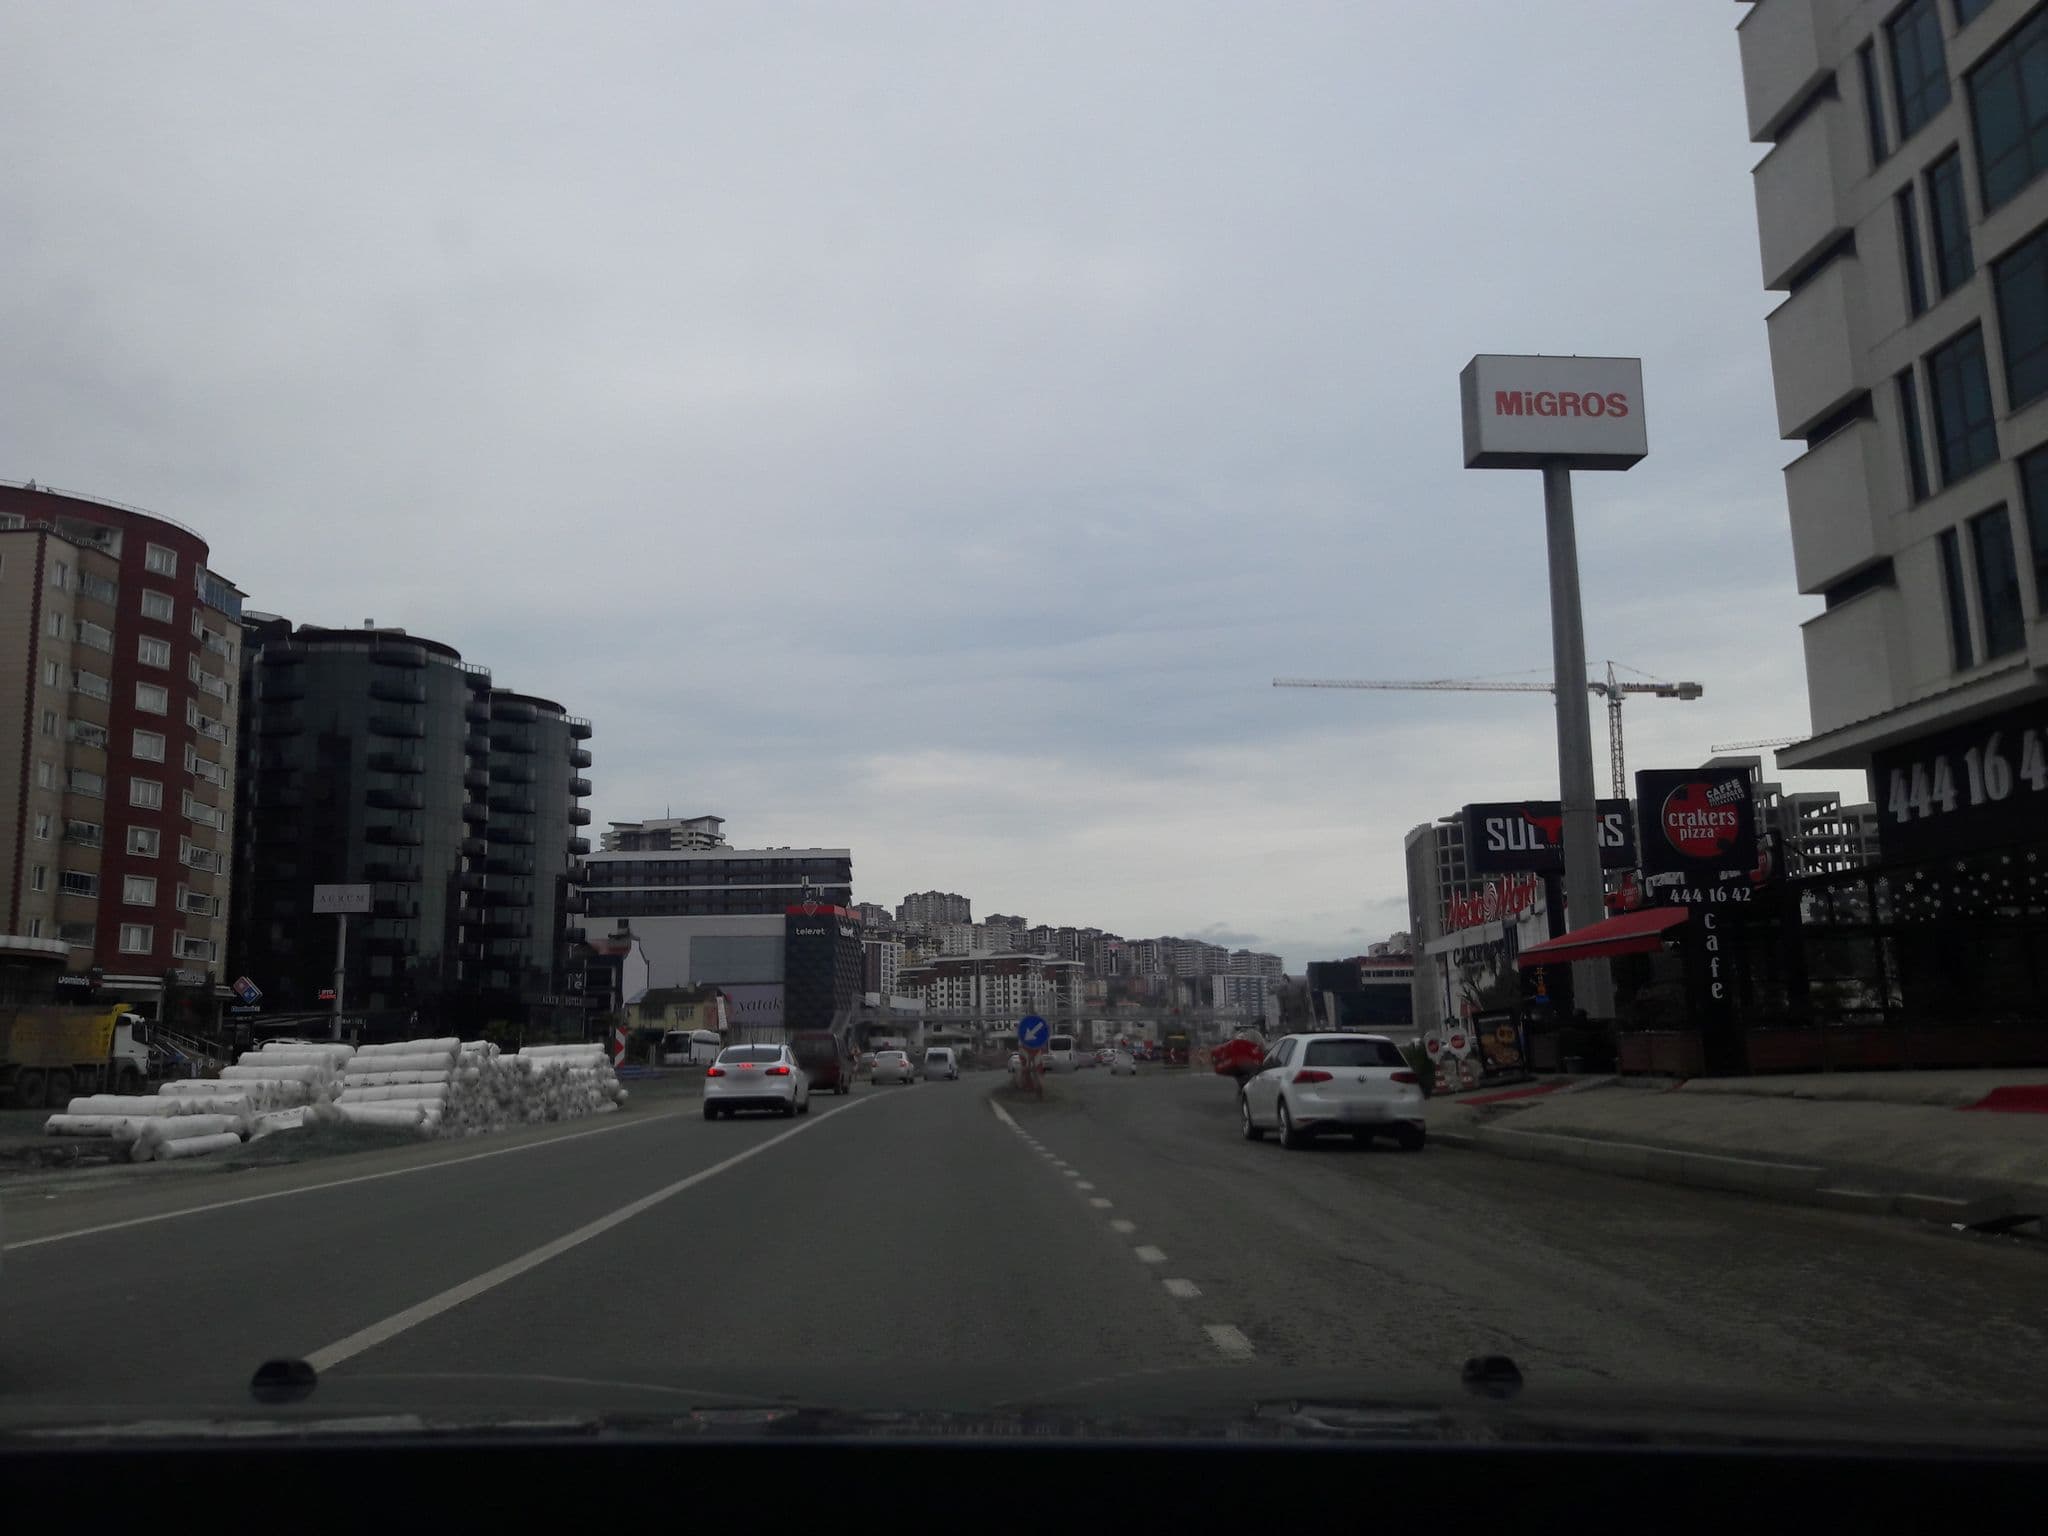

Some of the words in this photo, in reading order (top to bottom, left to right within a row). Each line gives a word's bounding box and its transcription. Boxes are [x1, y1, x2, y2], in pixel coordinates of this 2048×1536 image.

[1495, 390, 1629, 418] MiGROS
[1888, 754, 1959, 824] 444
[1964, 730, 2014, 806] 16
[1668, 808, 1736, 827] crakers
[1680, 826, 1715, 841] pizza
[1670, 888, 1703, 903] 444
[1709, 886, 1727, 902] 16
[1732, 887, 1752, 902] 42
